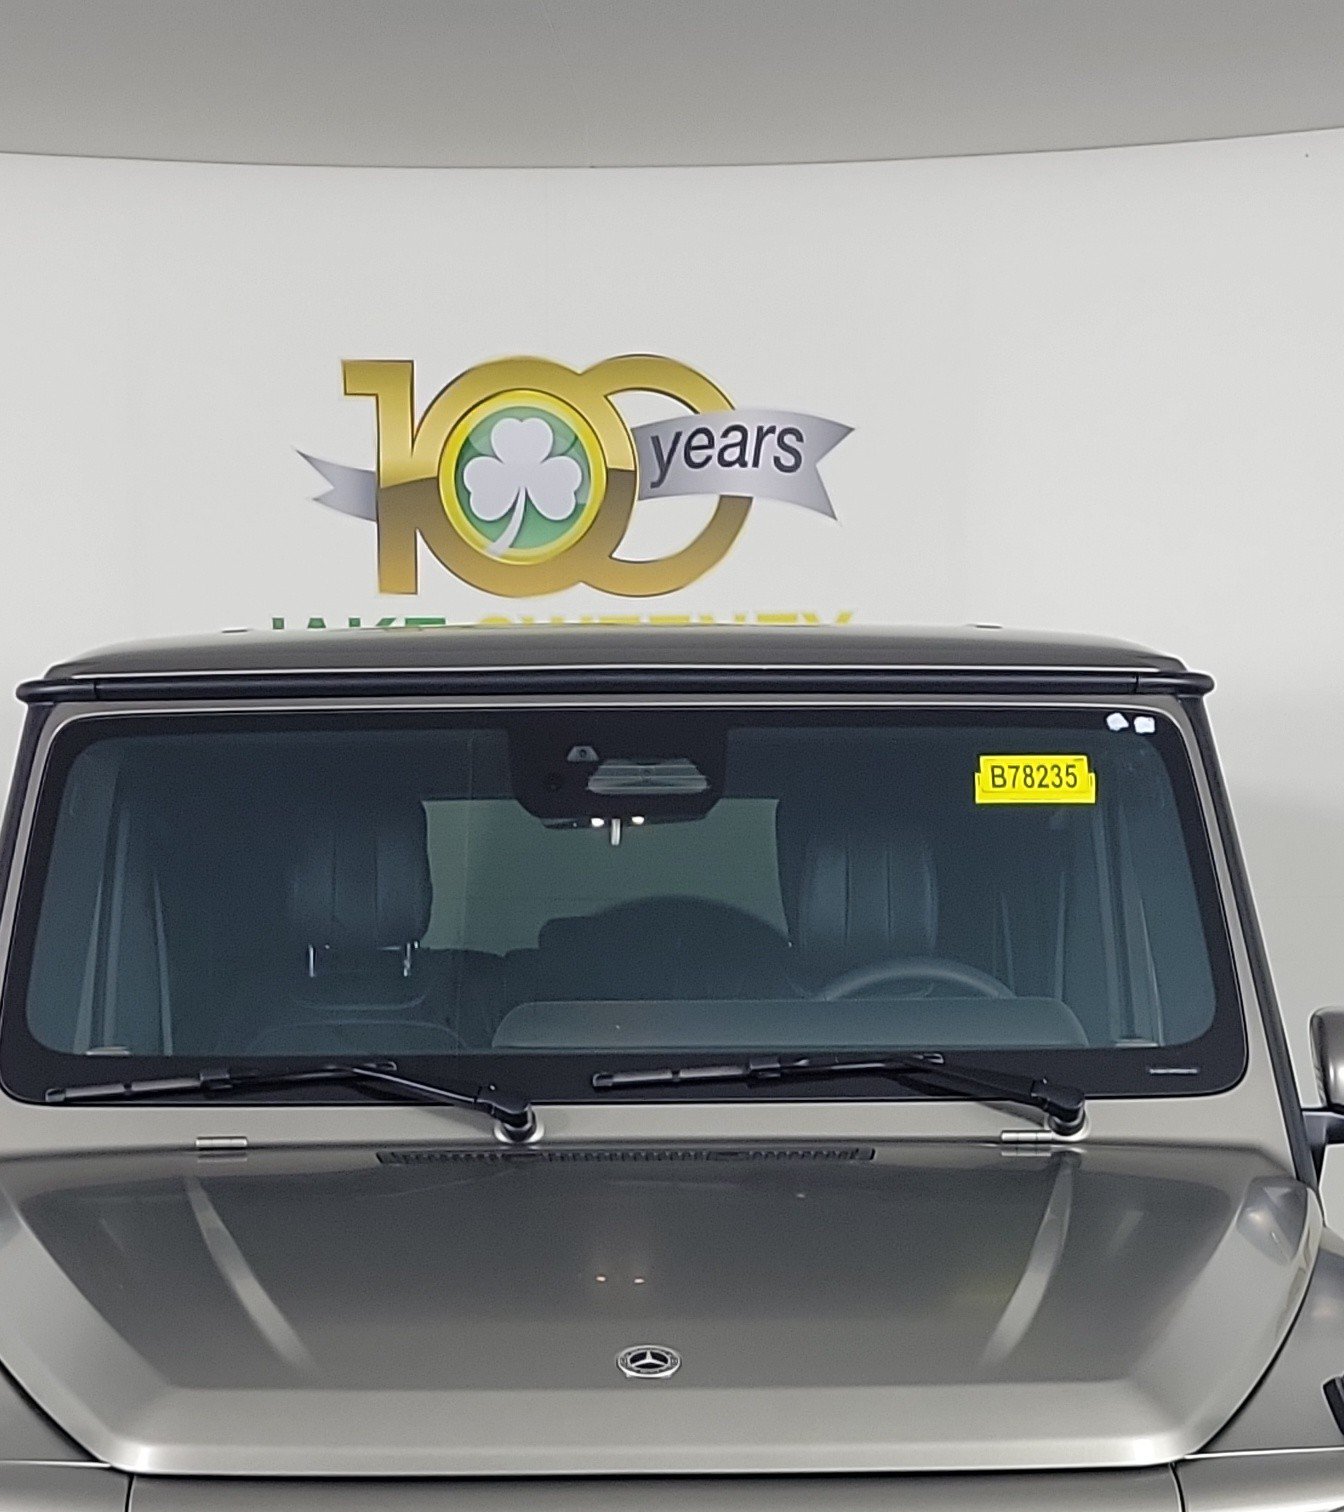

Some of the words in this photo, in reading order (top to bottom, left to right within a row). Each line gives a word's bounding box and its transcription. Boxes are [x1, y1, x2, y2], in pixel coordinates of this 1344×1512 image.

[341, 353, 753, 598] 100
[649, 423, 805, 489] years
[990, 764, 1078, 789] B78235
